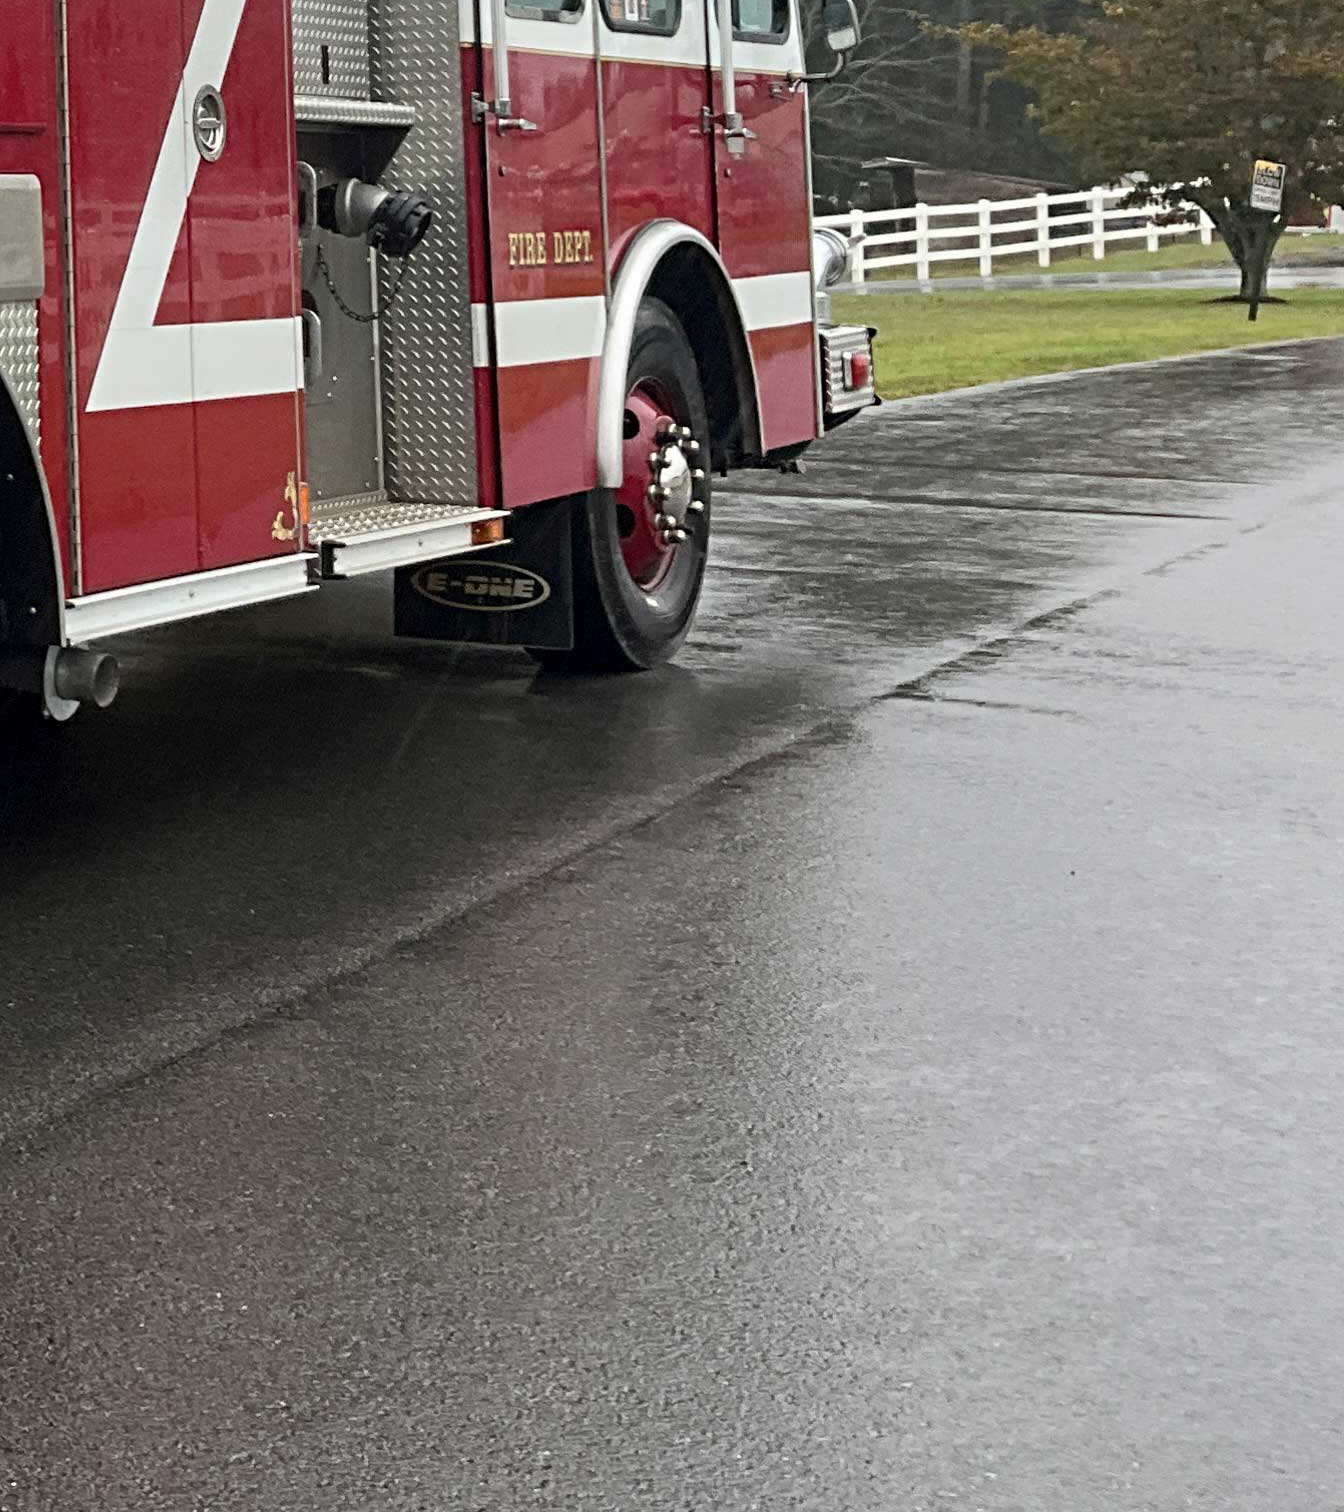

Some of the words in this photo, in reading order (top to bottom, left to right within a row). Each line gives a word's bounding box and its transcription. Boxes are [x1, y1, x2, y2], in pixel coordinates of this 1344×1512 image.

[508, 232, 547, 266] FIRE
[553, 230, 594, 264] DEPT.
[426, 572, 536, 598] E-ONE
